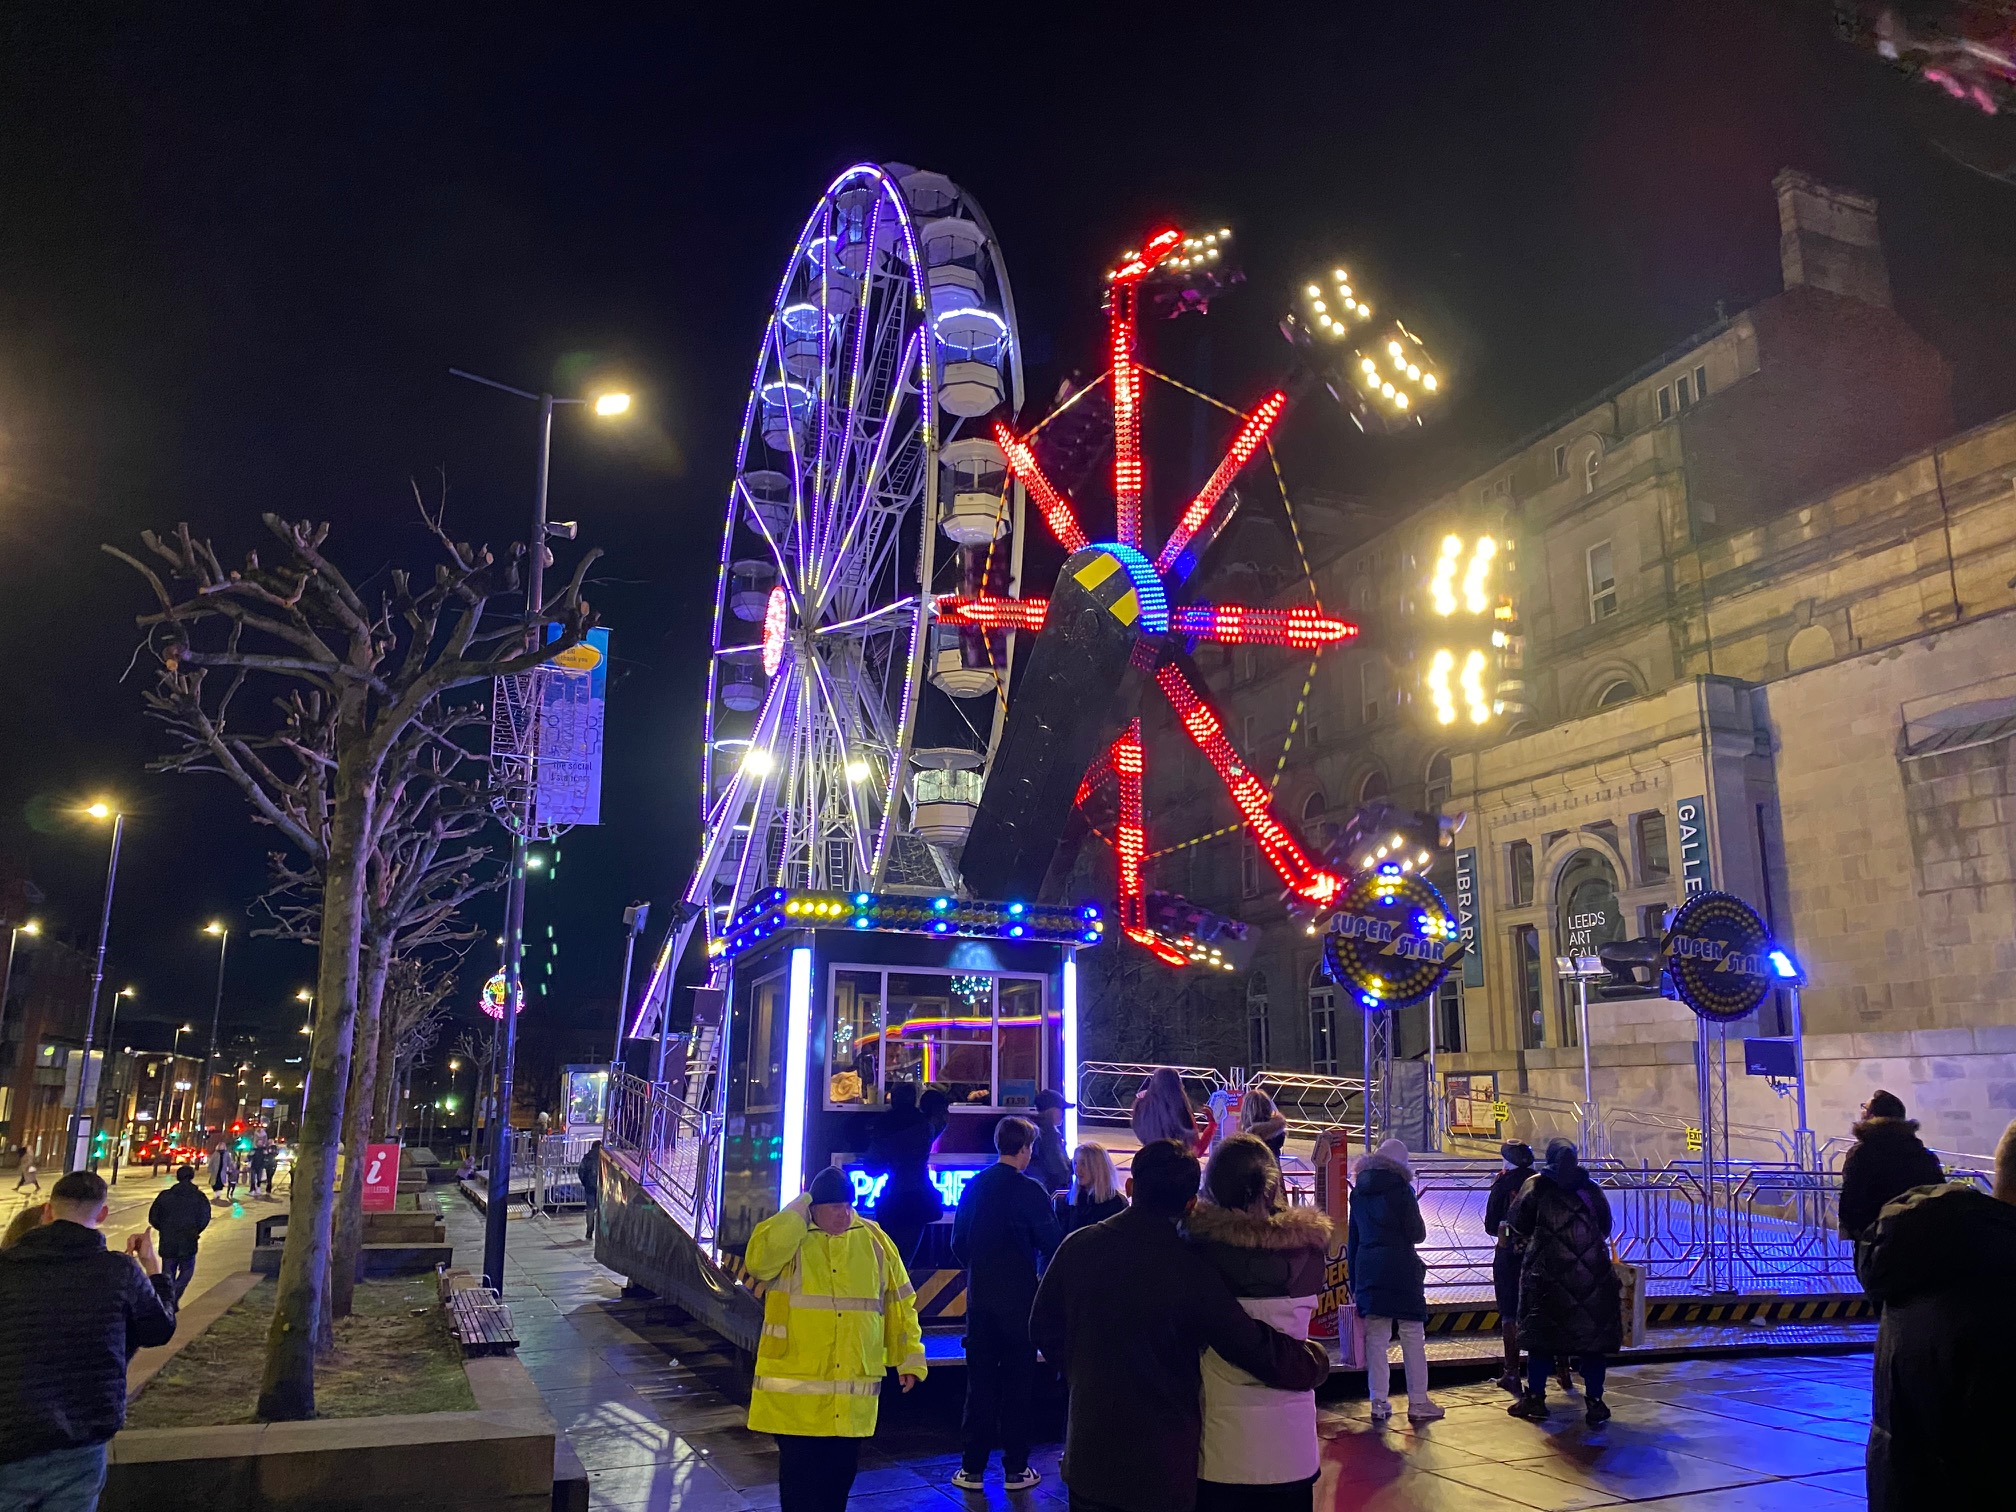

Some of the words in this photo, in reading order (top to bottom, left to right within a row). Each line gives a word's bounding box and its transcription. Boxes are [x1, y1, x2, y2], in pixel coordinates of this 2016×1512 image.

[1679, 804, 1703, 893] GALLE
[1456, 853, 1475, 955] LIBRARY
[1568, 911, 1606, 930] LEEDS
[1329, 911, 1393, 942] SUPER
[1395, 933, 1446, 964] STAR
[1569, 929, 1592, 946] ART
[1672, 935, 1723, 961] SUPER
[1495, 1104, 1507, 1112] EXIT
